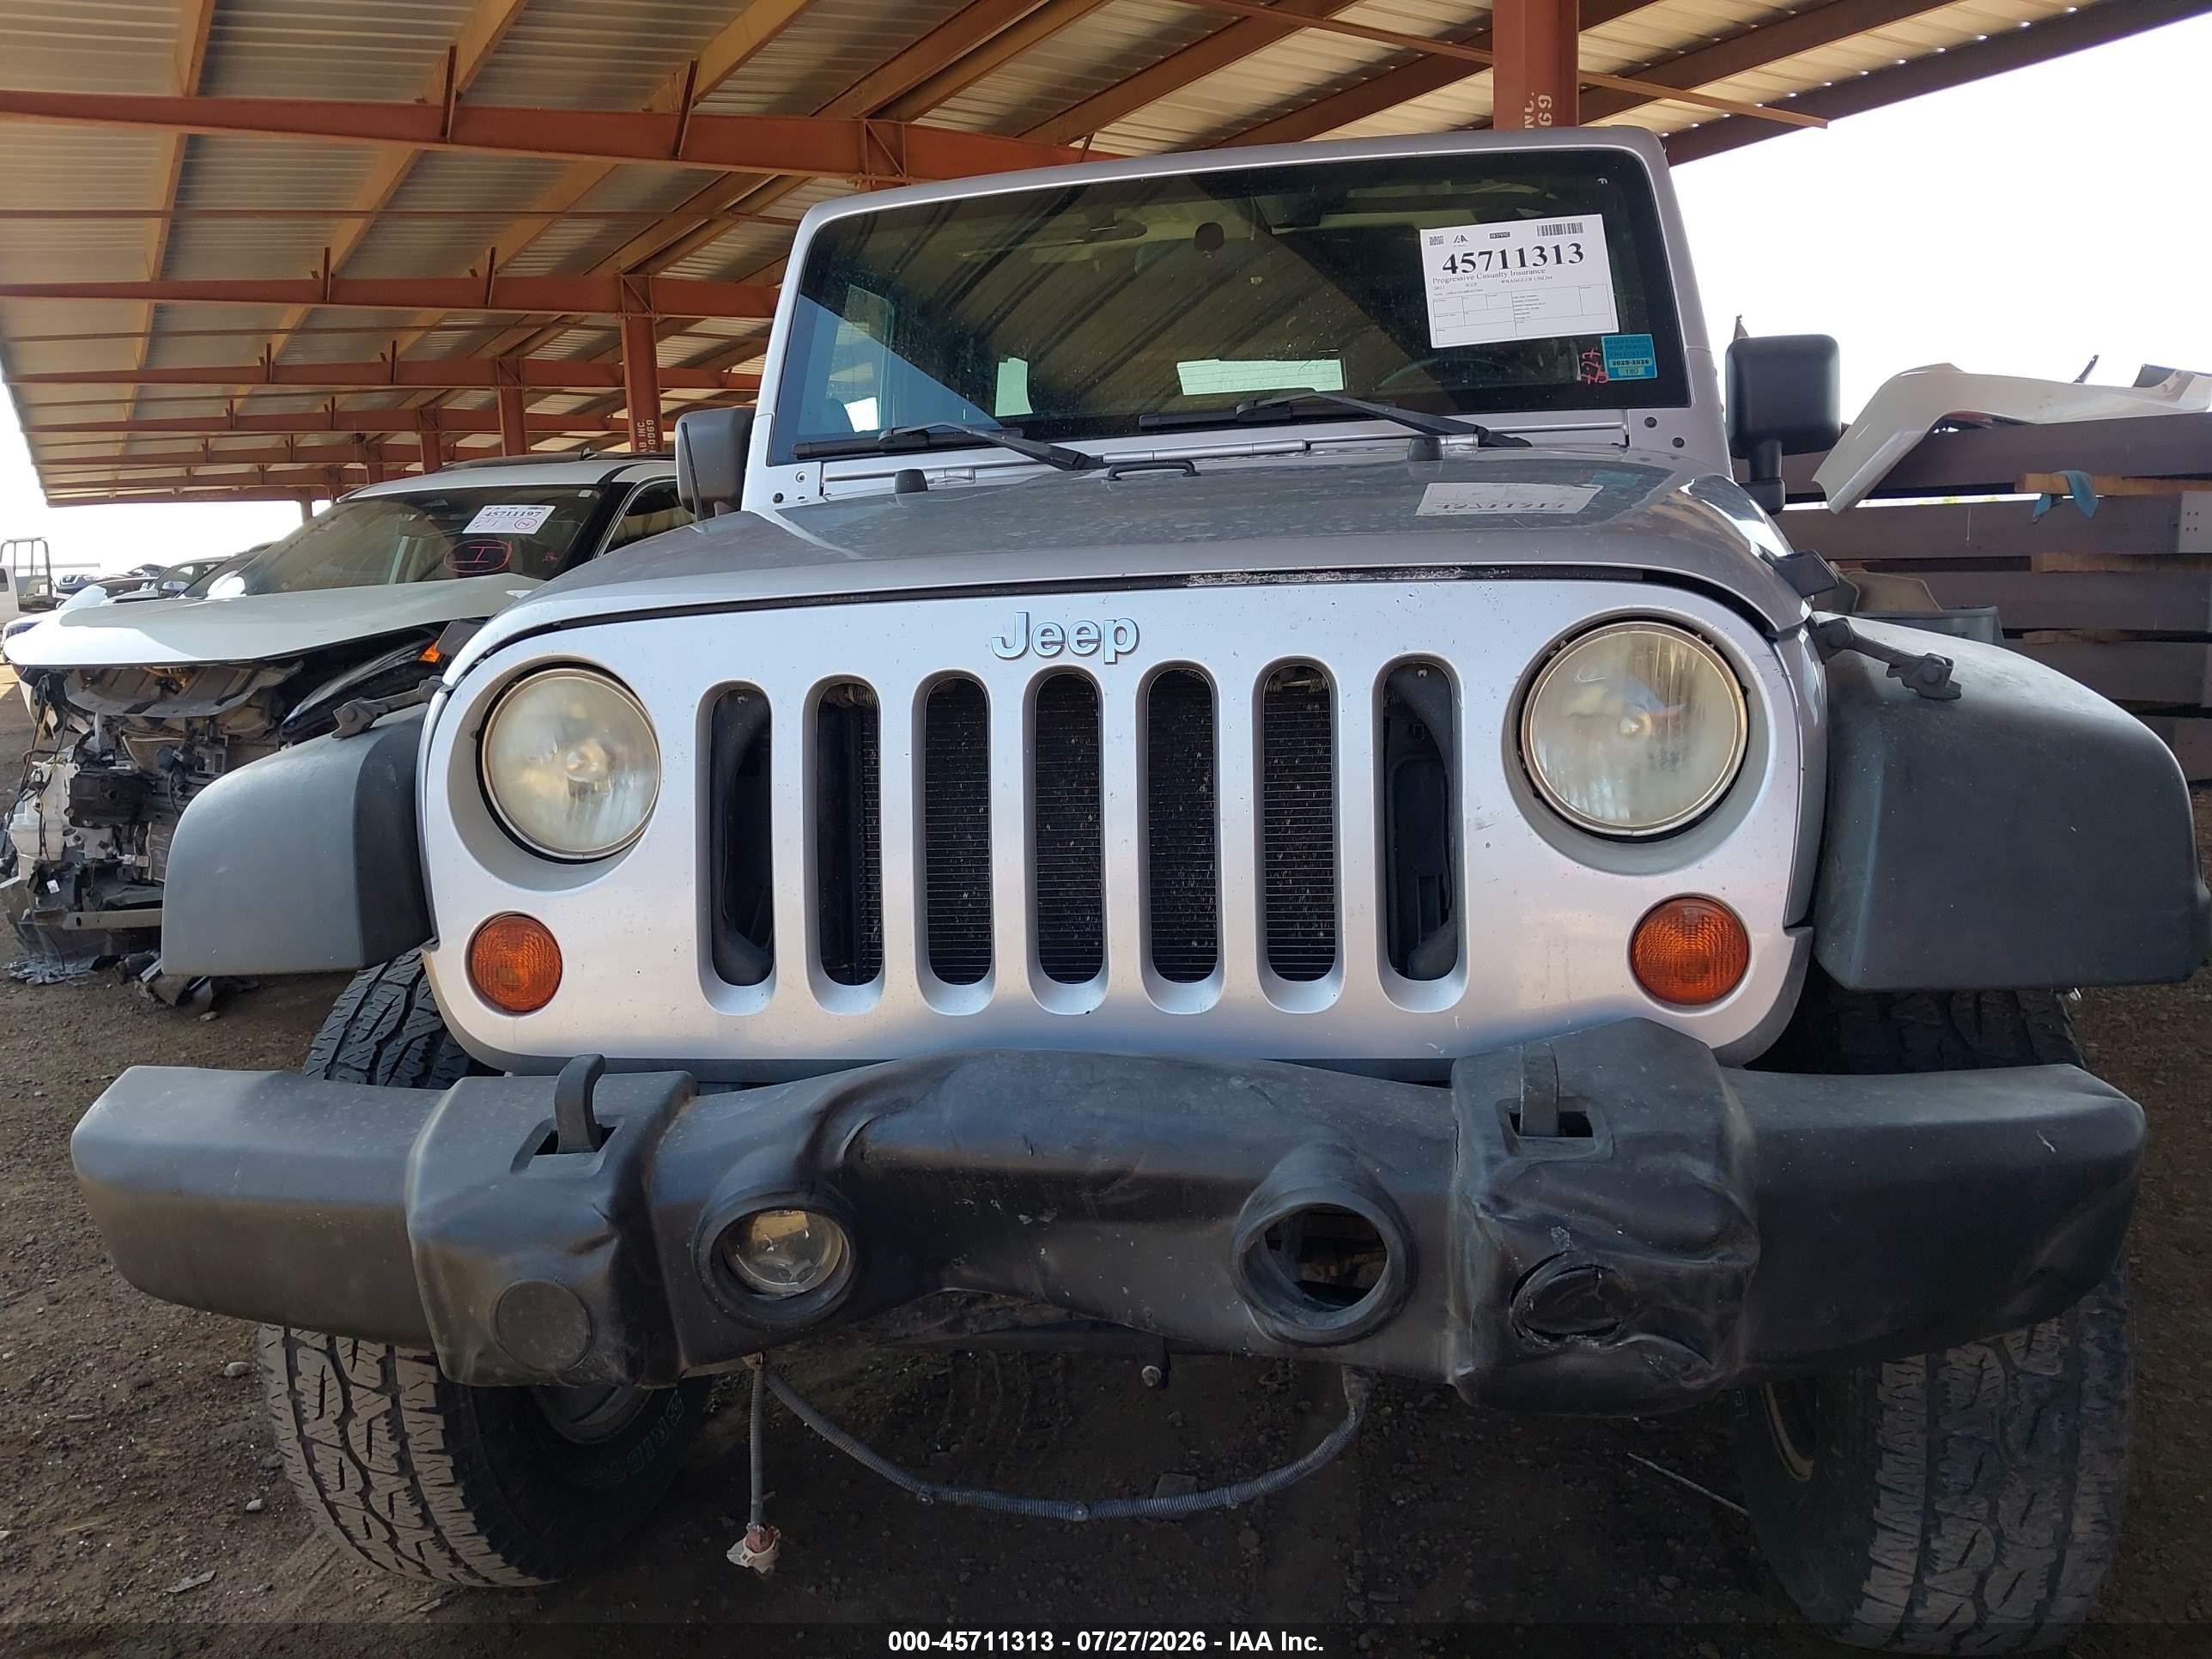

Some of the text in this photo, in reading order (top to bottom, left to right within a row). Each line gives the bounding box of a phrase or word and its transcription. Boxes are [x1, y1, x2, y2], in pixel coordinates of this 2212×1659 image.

[1442, 241, 1584, 275] 45711313
[1432, 274, 1475, 284] Progressive
[1476, 270, 1508, 279] Casualty
[990, 611, 1140, 665] Jeep
